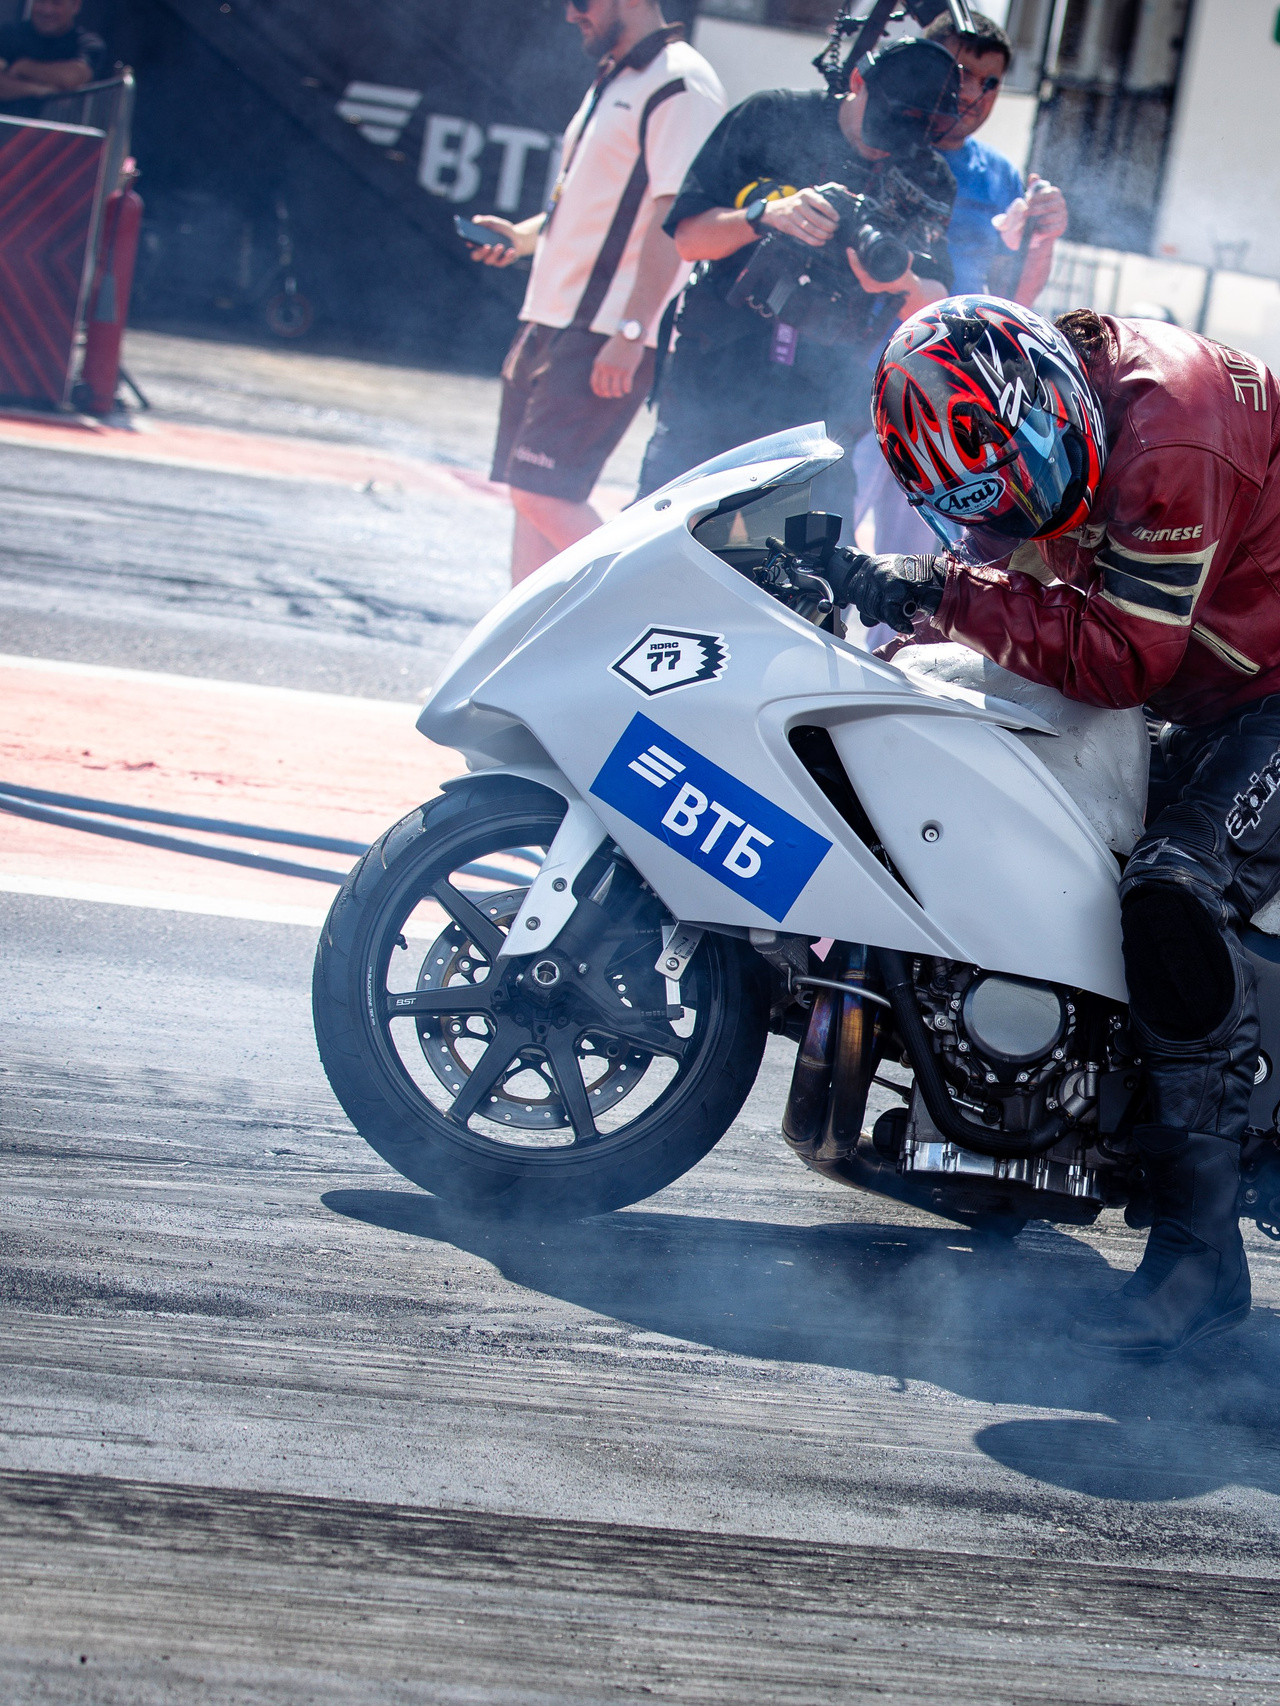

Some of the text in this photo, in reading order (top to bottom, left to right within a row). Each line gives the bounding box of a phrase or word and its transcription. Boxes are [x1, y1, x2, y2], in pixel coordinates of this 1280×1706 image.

[941, 481, 995, 512] Arai
[650, 642, 679, 651] RDRC
[647, 650, 681, 672] 77
[661, 781, 775, 879] ВТБ
[395, 997, 417, 1006] BST
